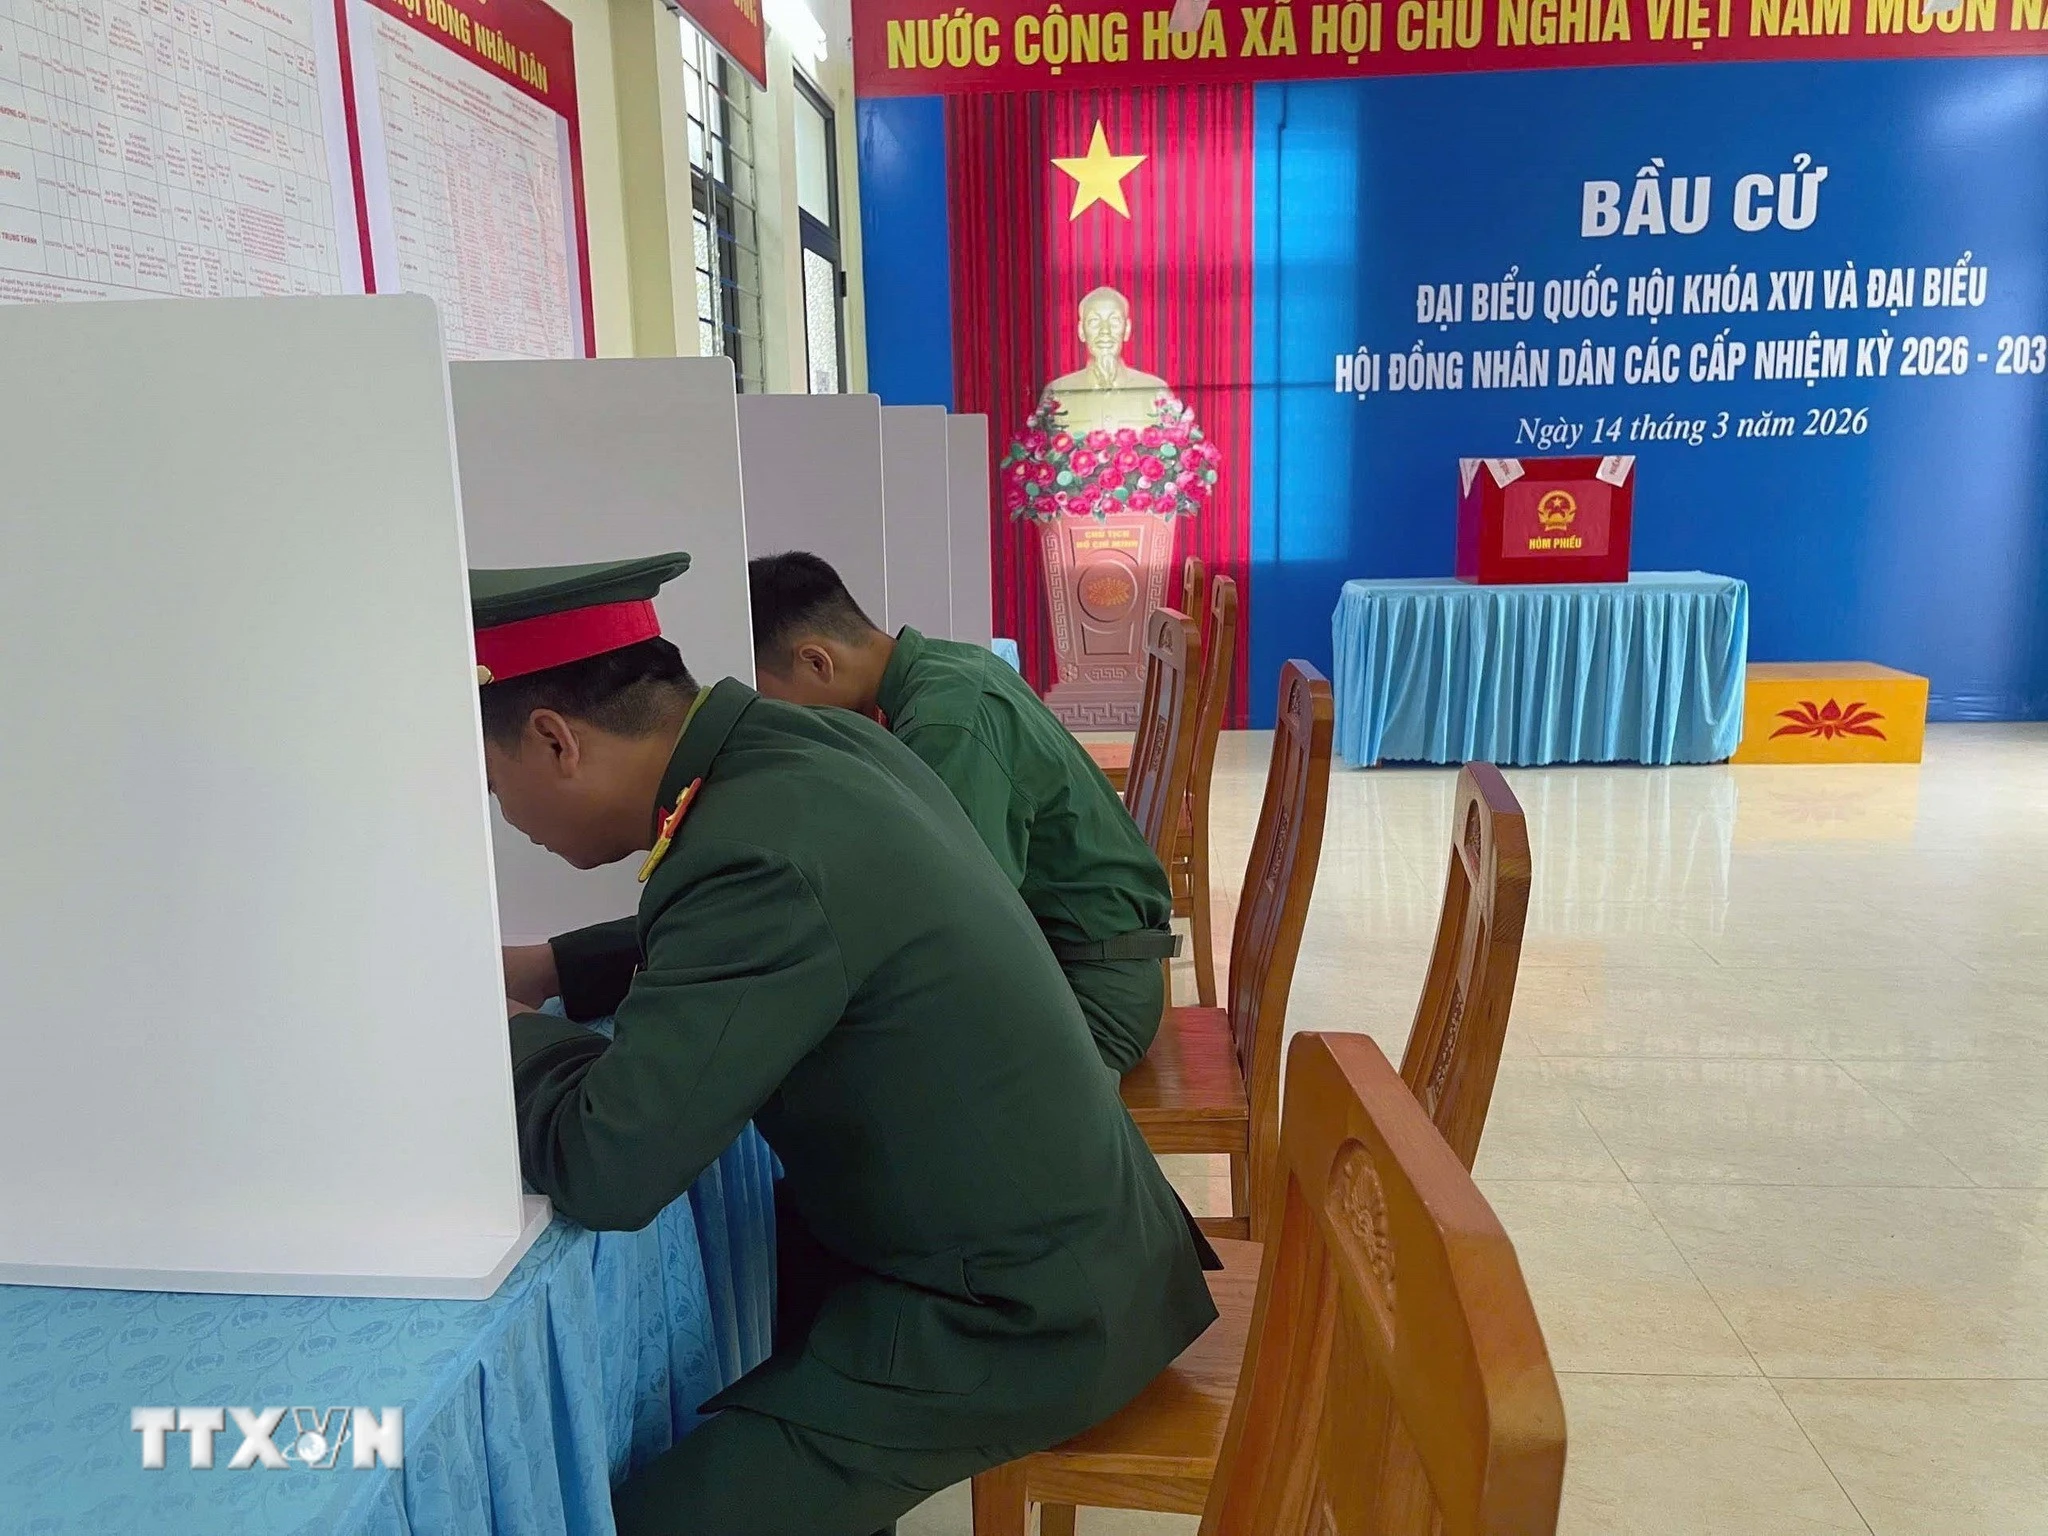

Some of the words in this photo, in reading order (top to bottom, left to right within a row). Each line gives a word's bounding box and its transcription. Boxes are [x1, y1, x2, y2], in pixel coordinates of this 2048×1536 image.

[474, 21, 517, 74] NHÂN
[519, 50, 548, 94] DÂN
[887, 8, 1000, 68] NƯỚC
[1015, 4, 1128, 75] CỘNG
[1750, 0, 1849, 37] NAM
[1581, 157, 1711, 237] BẦU
[1733, 152, 1828, 232] CỬ
[1417, 284, 1462, 331] ĐẠI
[1472, 265, 1535, 321] BIỂU
[1543, 264, 1618, 324] QUỐC
[1627, 267, 1675, 324] HỘI
[1682, 264, 1759, 314] KHÓA
[1767, 270, 1814, 311] XVI
[1823, 260, 1858, 309] VÀ
[1867, 268, 1915, 316] ĐẠI
[1923, 250, 1987, 307] BIỂU
[1335, 346, 1380, 400] HỘI
[1388, 339, 1464, 391] ĐỒNG
[1472, 341, 1549, 389] NHÂN
[1558, 339, 1616, 387] DÂN
[1624, 337, 1680, 384] CÁC
[1689, 328, 1746, 382] CẤP
[1754, 331, 1848, 387] NHIỆM
[1856, 329, 1895, 377] KỲ
[1899, 336, 1970, 375] 2026
[1515, 416, 1583, 450] Ngày
[1591, 416, 1623, 444] 14
[1630, 413, 1706, 446] tháng
[1712, 411, 1730, 439] 3
[1737, 410, 1796, 437] năm
[1803, 406, 1870, 436] 2026
[1529, 536, 1551, 550] HÒM
[1553, 535, 1582, 549] PHIẾU
